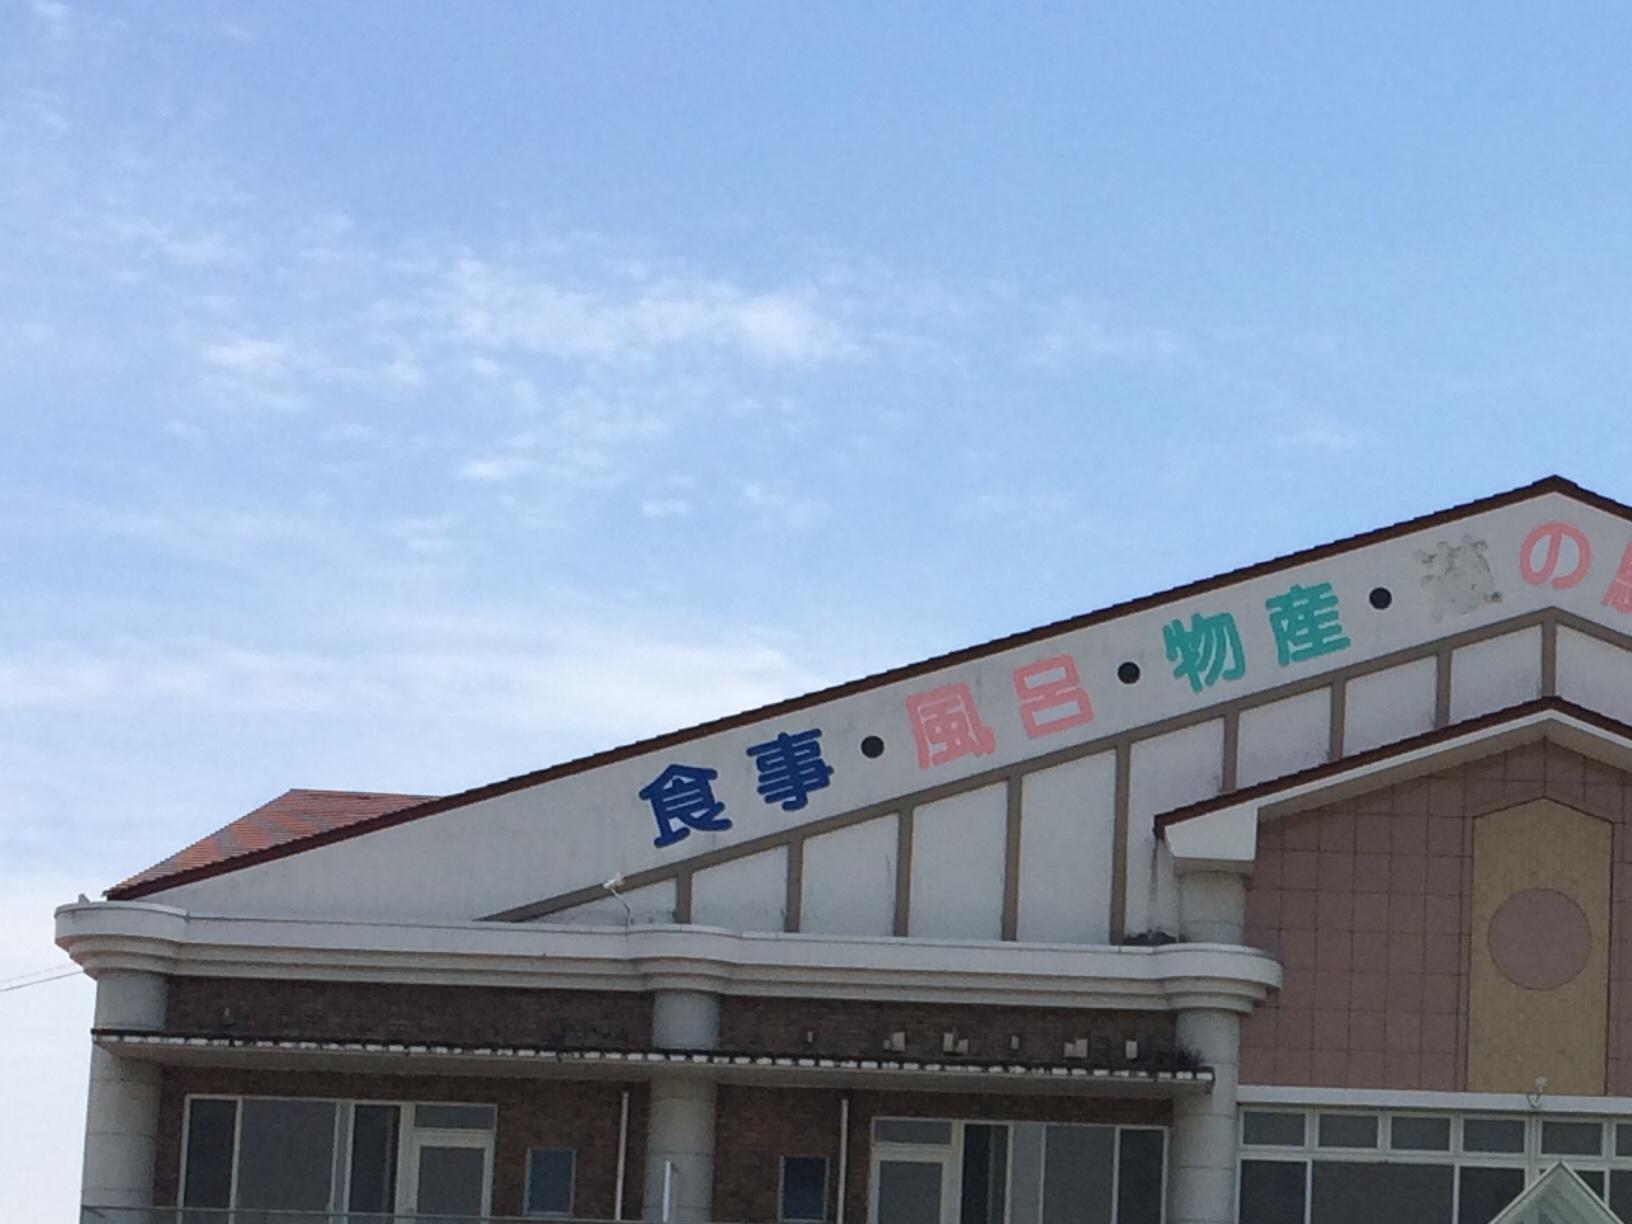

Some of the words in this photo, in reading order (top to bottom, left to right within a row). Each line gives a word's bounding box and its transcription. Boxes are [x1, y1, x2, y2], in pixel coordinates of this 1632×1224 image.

[1163, 581, 1351, 692] 物産
[905, 653, 1094, 769] 風呂
[638, 728, 835, 848] 食事
